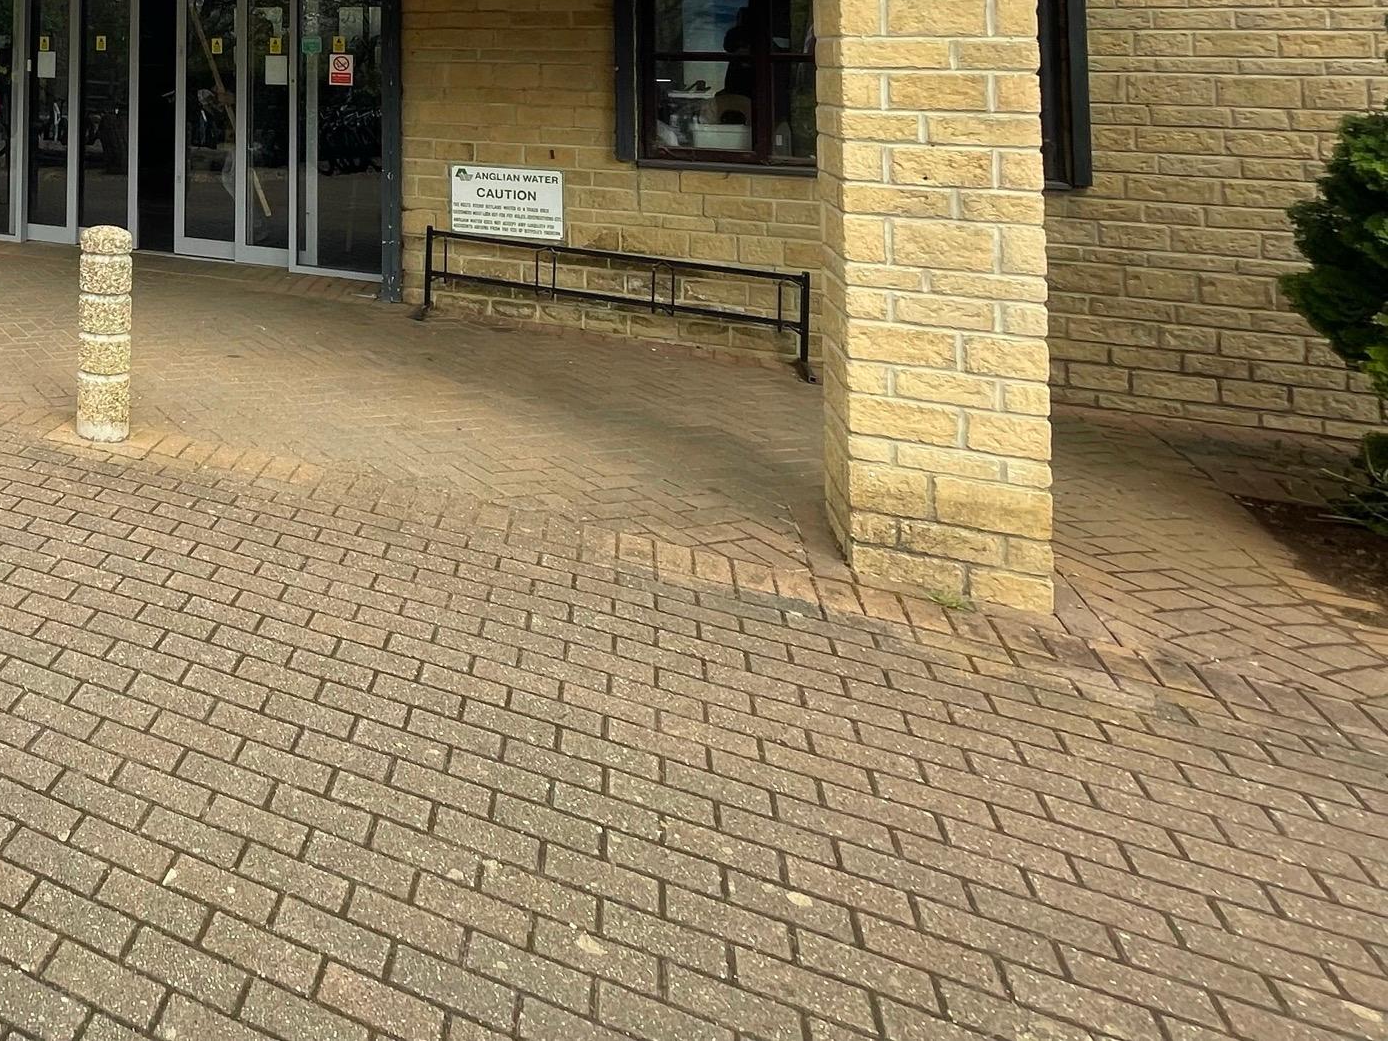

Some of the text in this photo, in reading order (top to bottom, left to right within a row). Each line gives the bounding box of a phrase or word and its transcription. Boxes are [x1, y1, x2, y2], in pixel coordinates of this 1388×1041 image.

[475, 172, 559, 184] ANGLIAN WATER
[476, 187, 537, 201] CAUTION
